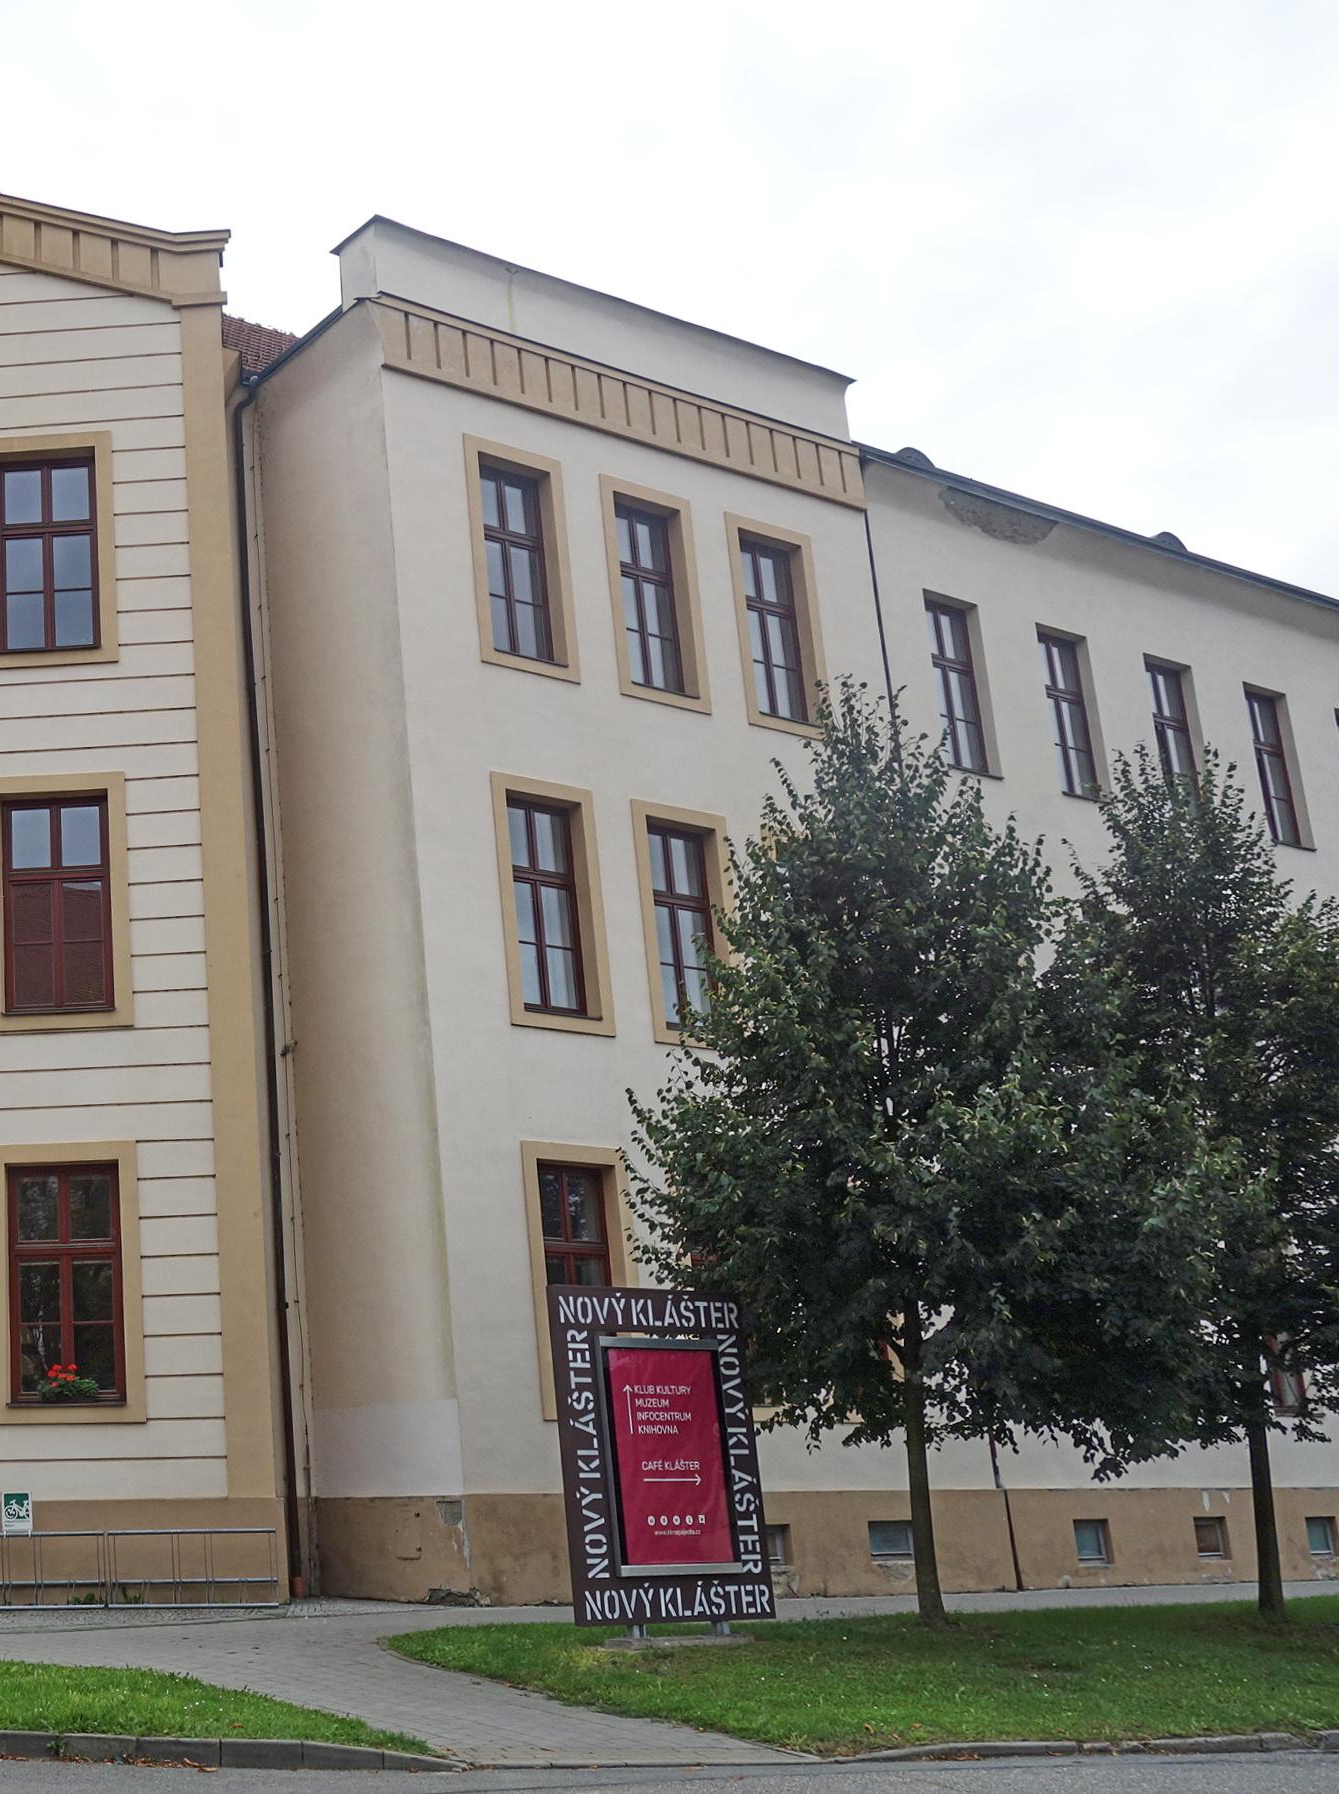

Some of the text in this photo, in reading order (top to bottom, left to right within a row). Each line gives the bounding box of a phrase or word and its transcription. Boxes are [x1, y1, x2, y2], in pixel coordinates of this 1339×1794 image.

[558, 1292, 739, 1329] NOVÝ KLÁŠTER
[634, 1384, 691, 1395] KLUB KULTURY
[635, 1398, 669, 1408] MUZEUM
[636, 1411, 692, 1421] INFOCENTRUM
[638, 1425, 678, 1435] KNIHOVNA
[566, 1329, 611, 1579] NOVÝ KLÁŠTER
[716, 1334, 763, 1575] NOVÝ KLÁŠTER
[641, 1458, 700, 1471] CAFÉ KLÁŠTER
[585, 1580, 771, 1620] NOVÝ KLÁŠTER
